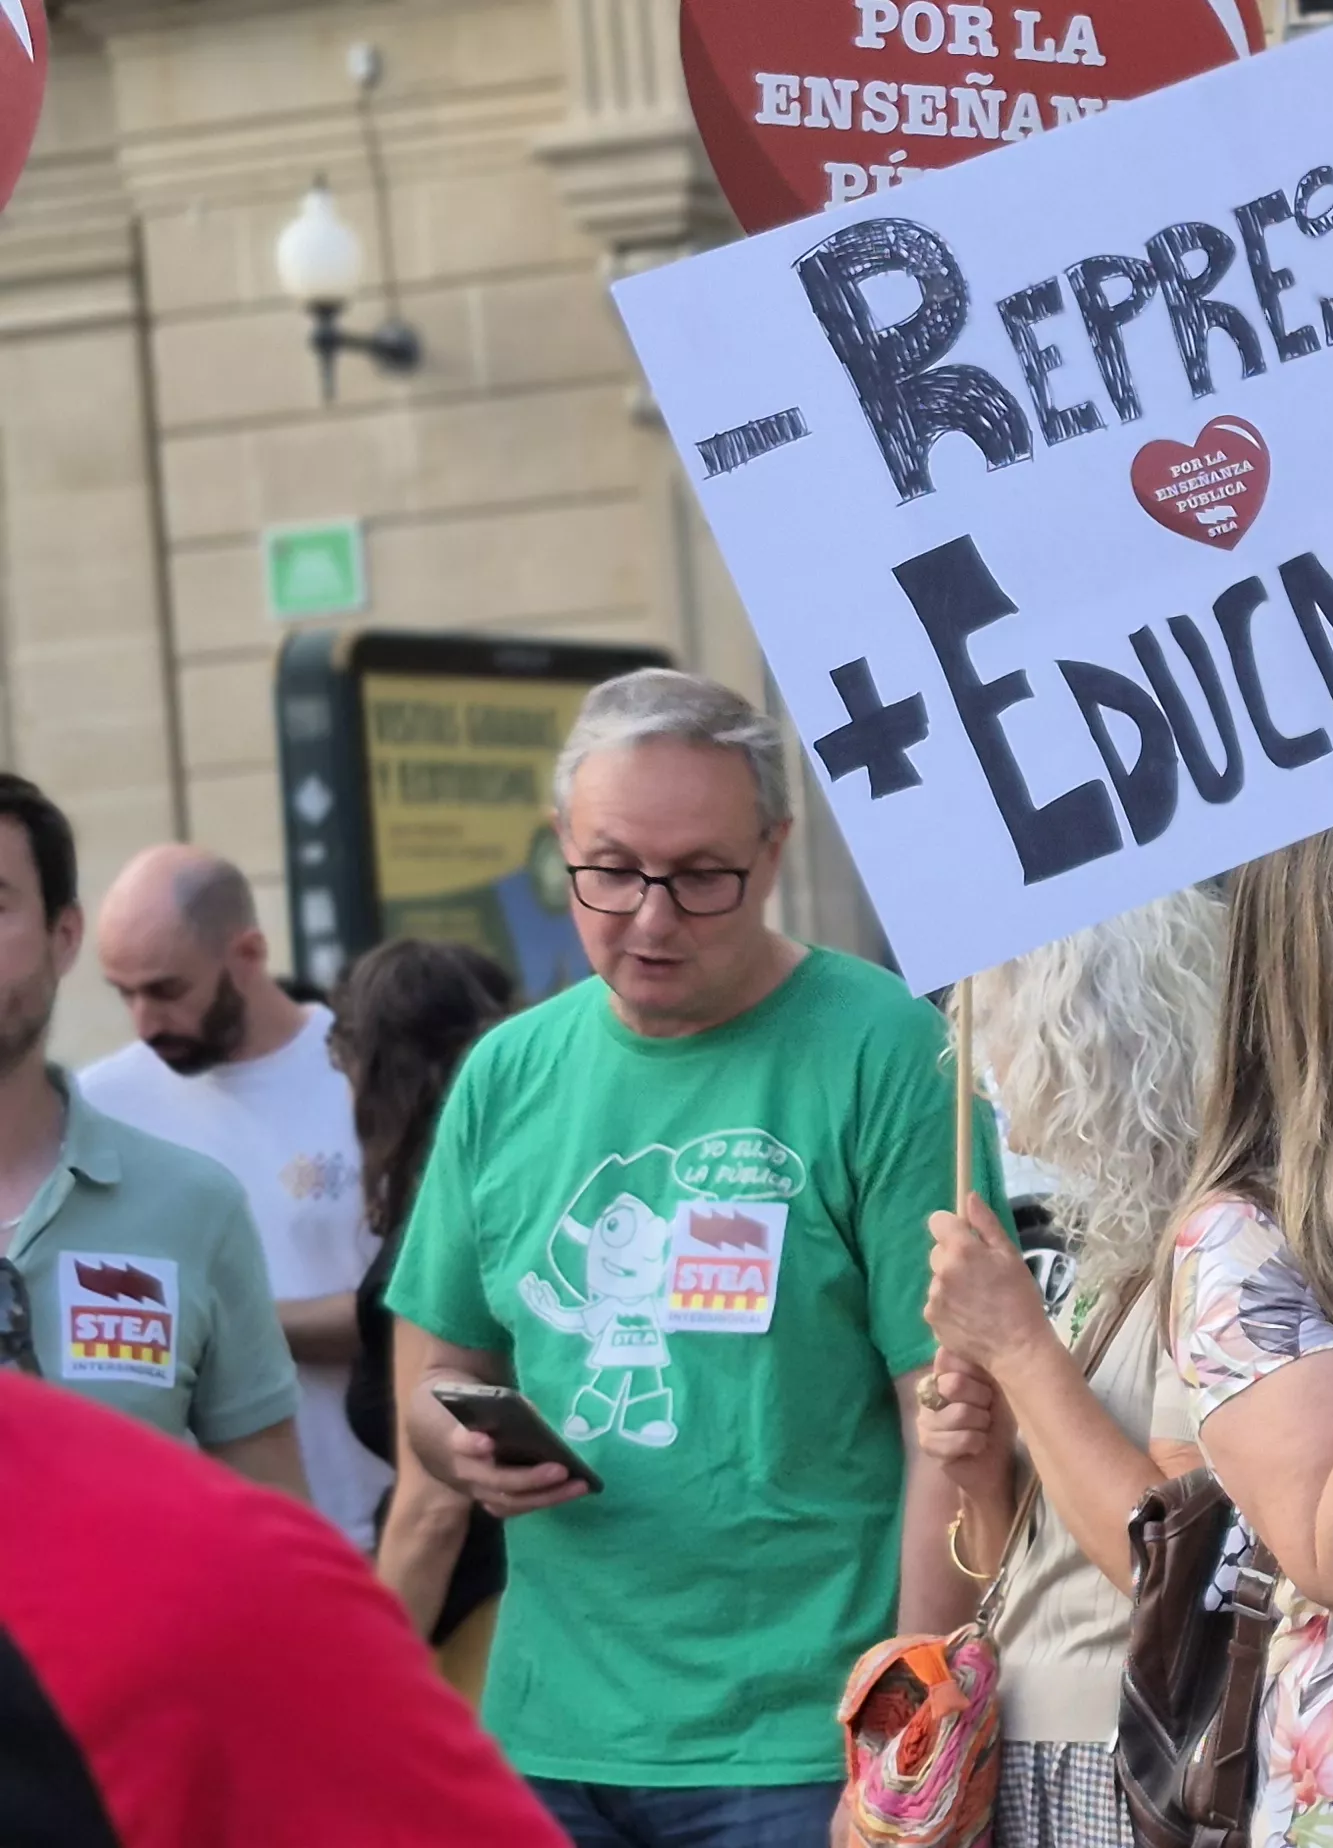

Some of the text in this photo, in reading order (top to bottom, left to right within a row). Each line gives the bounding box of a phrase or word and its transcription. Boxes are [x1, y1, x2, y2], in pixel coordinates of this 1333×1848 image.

[854, 0, 1106, 66] POR LA
[1154, 459, 1255, 502] ENSEÑANZA
[1169, 450, 1228, 479] POR LA
[1176, 480, 1248, 514] PÚBLICA
[1207, 520, 1239, 538] STEA
[678, 1263, 766, 1293] STEA
[75, 1312, 167, 1346] STEA
